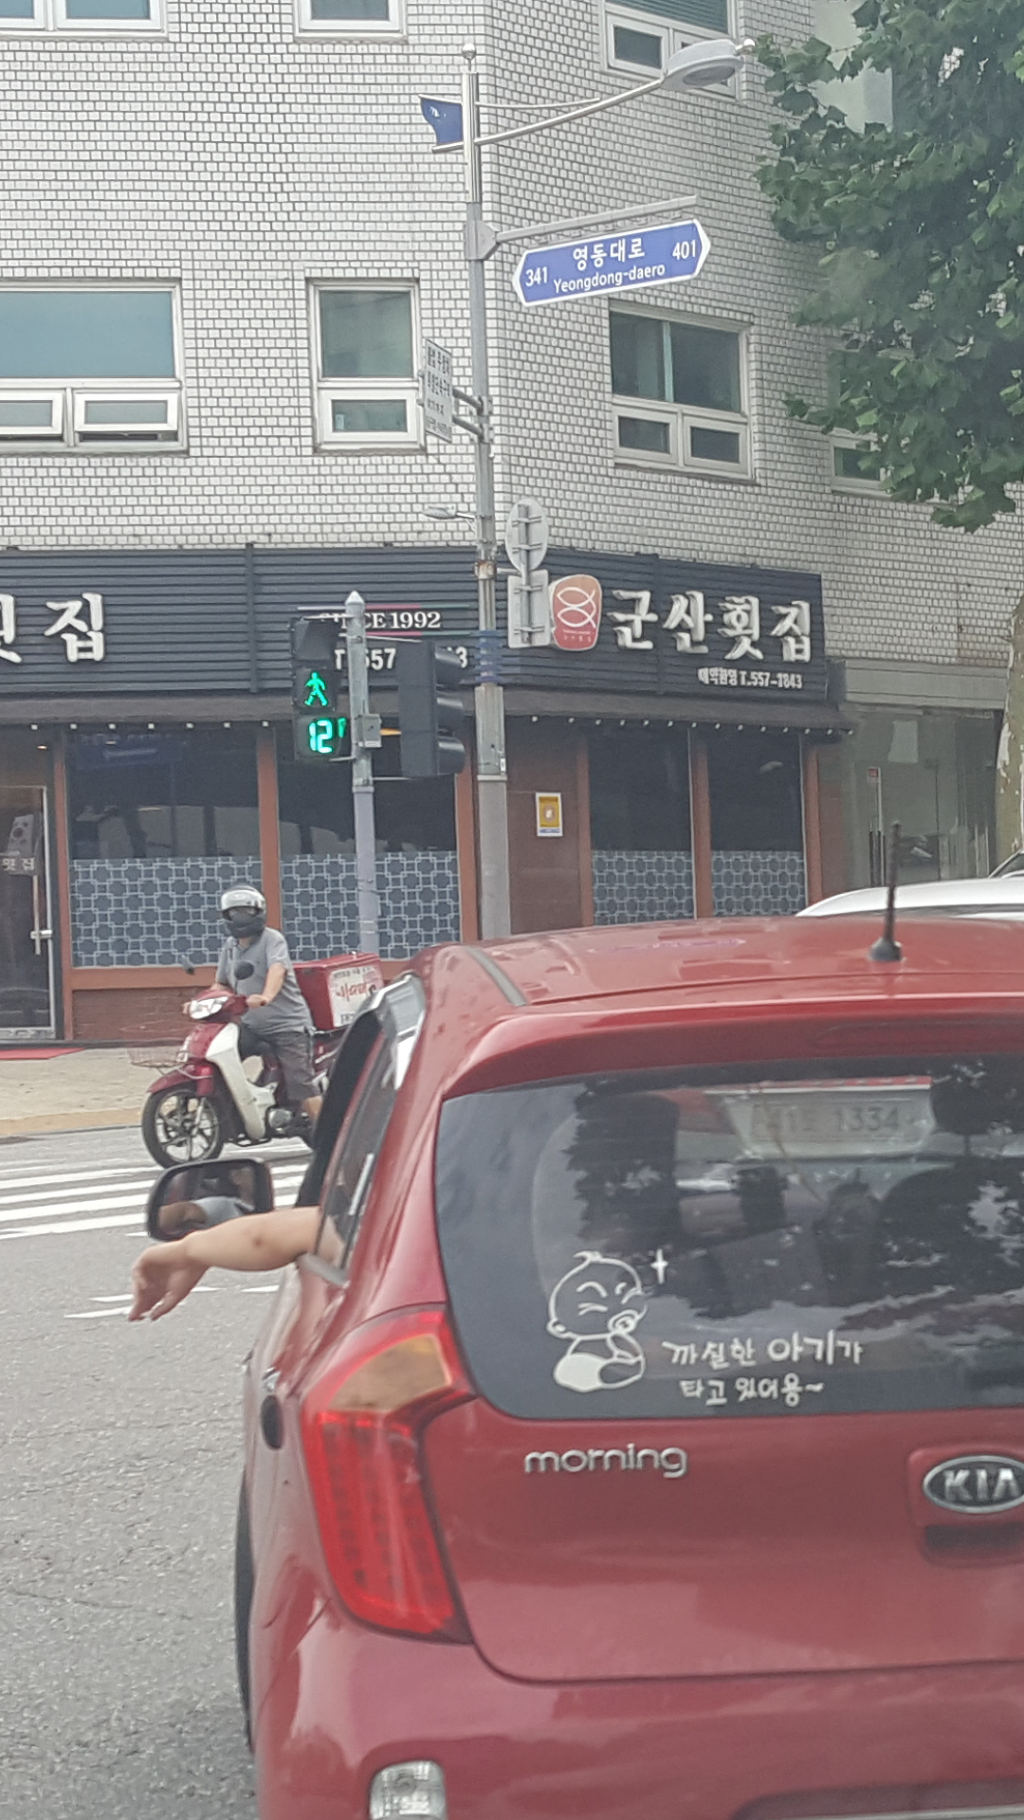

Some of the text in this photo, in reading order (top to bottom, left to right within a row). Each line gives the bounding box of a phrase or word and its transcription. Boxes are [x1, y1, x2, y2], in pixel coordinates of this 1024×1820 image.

[573, 238, 645, 271] 영동대로
[672, 240, 697, 260] 401
[525, 267, 548, 287] 341
[553, 264, 666, 293] Yeongdong-daero
[390, 611, 442, 630] 1992
[606, 589, 811, 663] 군산횟집
[767, 1329, 863, 1366] 아기가
[680, 1378, 728, 1406] 타고
[524, 1442, 688, 1479] morning
[942, 1467, 1020, 1500] KIA
